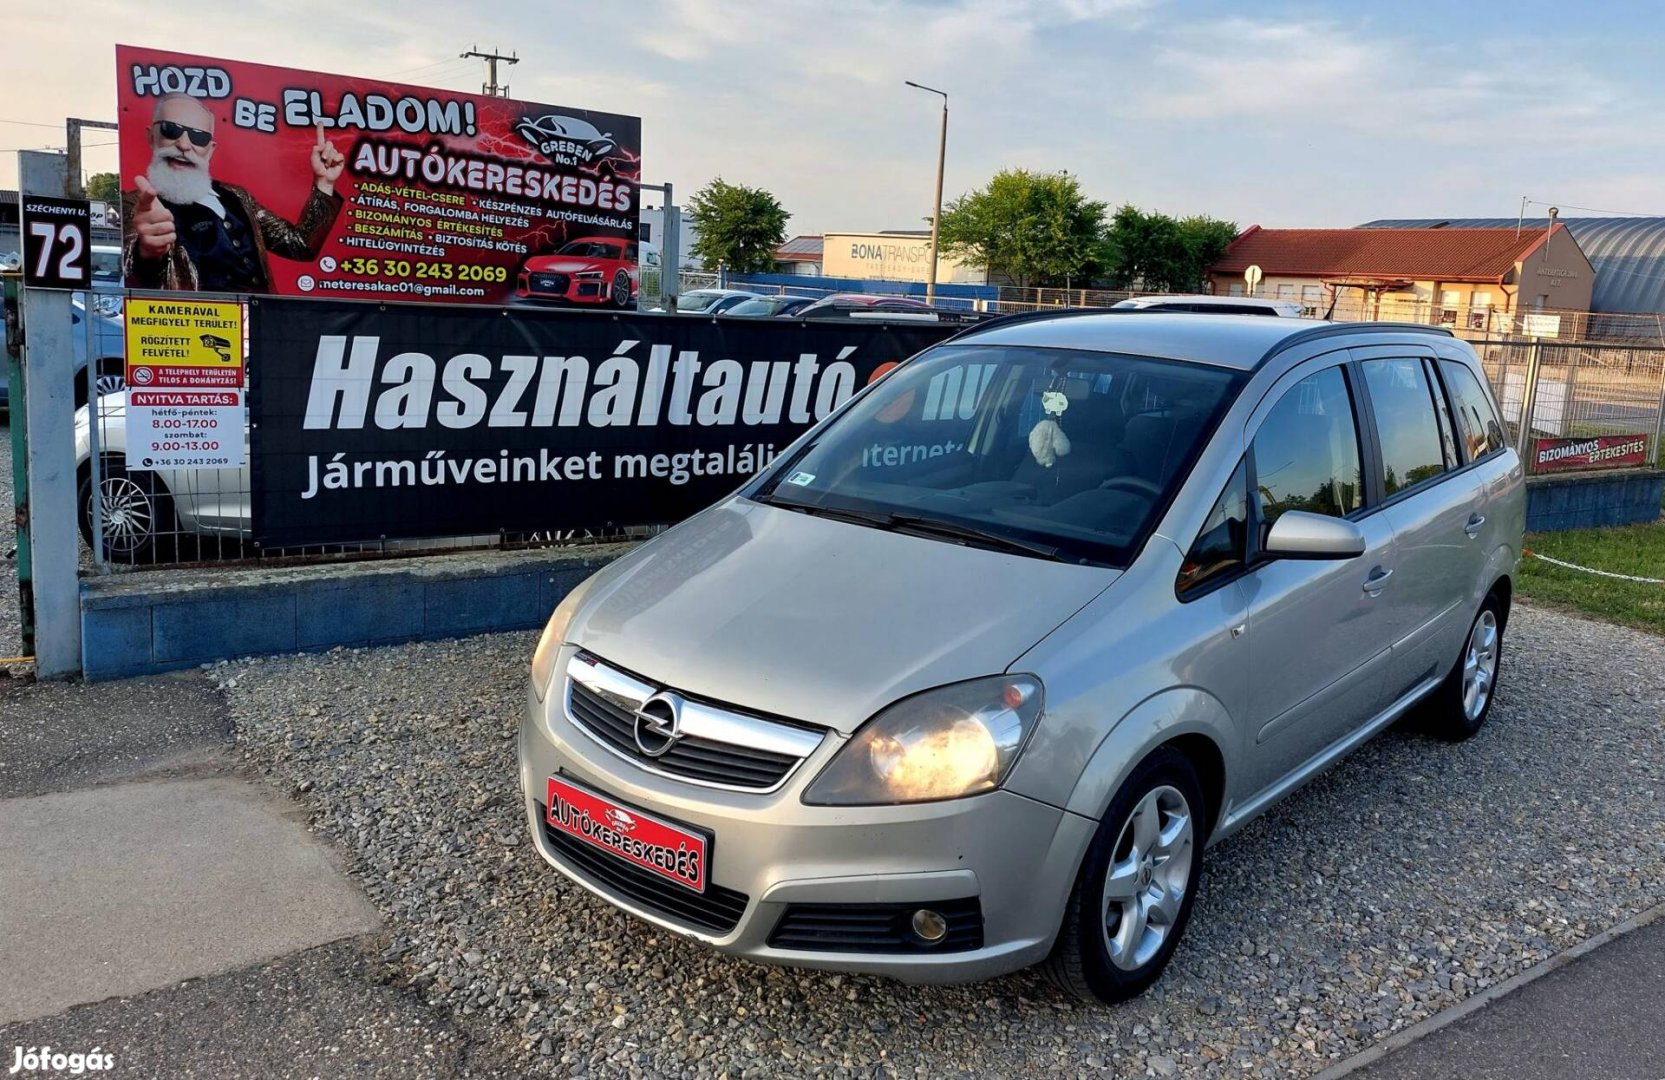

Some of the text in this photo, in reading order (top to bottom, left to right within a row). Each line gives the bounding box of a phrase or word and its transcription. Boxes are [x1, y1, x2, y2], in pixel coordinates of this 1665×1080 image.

[132, 65, 476, 136] HOZD BE ELADOM!
[540, 140, 593, 162] GREBEN
[555, 153, 577, 166] No.1
[354, 143, 631, 212] AUTÓKERESKEDÉS
[25, 204, 87, 217] SZÉCHENYI U.
[356, 195, 530, 228] ÁTÍRÁS, FORGALOMBA HELYEZÉS
[360, 182, 633, 230] ADÁS-VÉTEL-CSERE KÉSZPÉNZES AUTÓFELVÁSÁRLÁS
[355, 209, 503, 237] BIZOMÁNYOS ÉRTÉKESÍTÉS
[346, 237, 445, 257] HITELÜGYINTÉZÉS
[354, 223, 528, 254] BESZÁMÍTÁS BIZTOSÍTÁS KÖTÉS
[31, 221, 83, 280] 72
[340, 258, 507, 282] +36 30 243 2069
[148, 305, 220, 317] KAMERÁVAL
[131, 317, 238, 329] MEGFIGYELT TERÜLET!
[140, 334, 191, 346] RÖGZÍTETT
[142, 347, 190, 358] FELVÉTEL!
[158, 376, 181, 384] TILOS
[189, 376, 237, 385] DOHÁNYZÁS!
[165, 368, 199, 376] TELEPHELY
[201, 368, 237, 376] TERÜLETÉN
[136, 393, 233, 404] NYITVA TARTÁS:
[151, 409, 218, 418] hétfő-péntek:
[151, 419, 218, 429] 8.00-17.00
[164, 431, 207, 439] szombat:
[151, 441, 219, 451] 9.00-13.00
[1538, 440, 1599, 463] BIZOMÁNYOS
[1588, 439, 1644, 464] ÉRTÉKESÍTÉS
[301, 448, 602, 499] Járműveinket
[550, 792, 699, 882] AUTÓKERESKEDÉS
